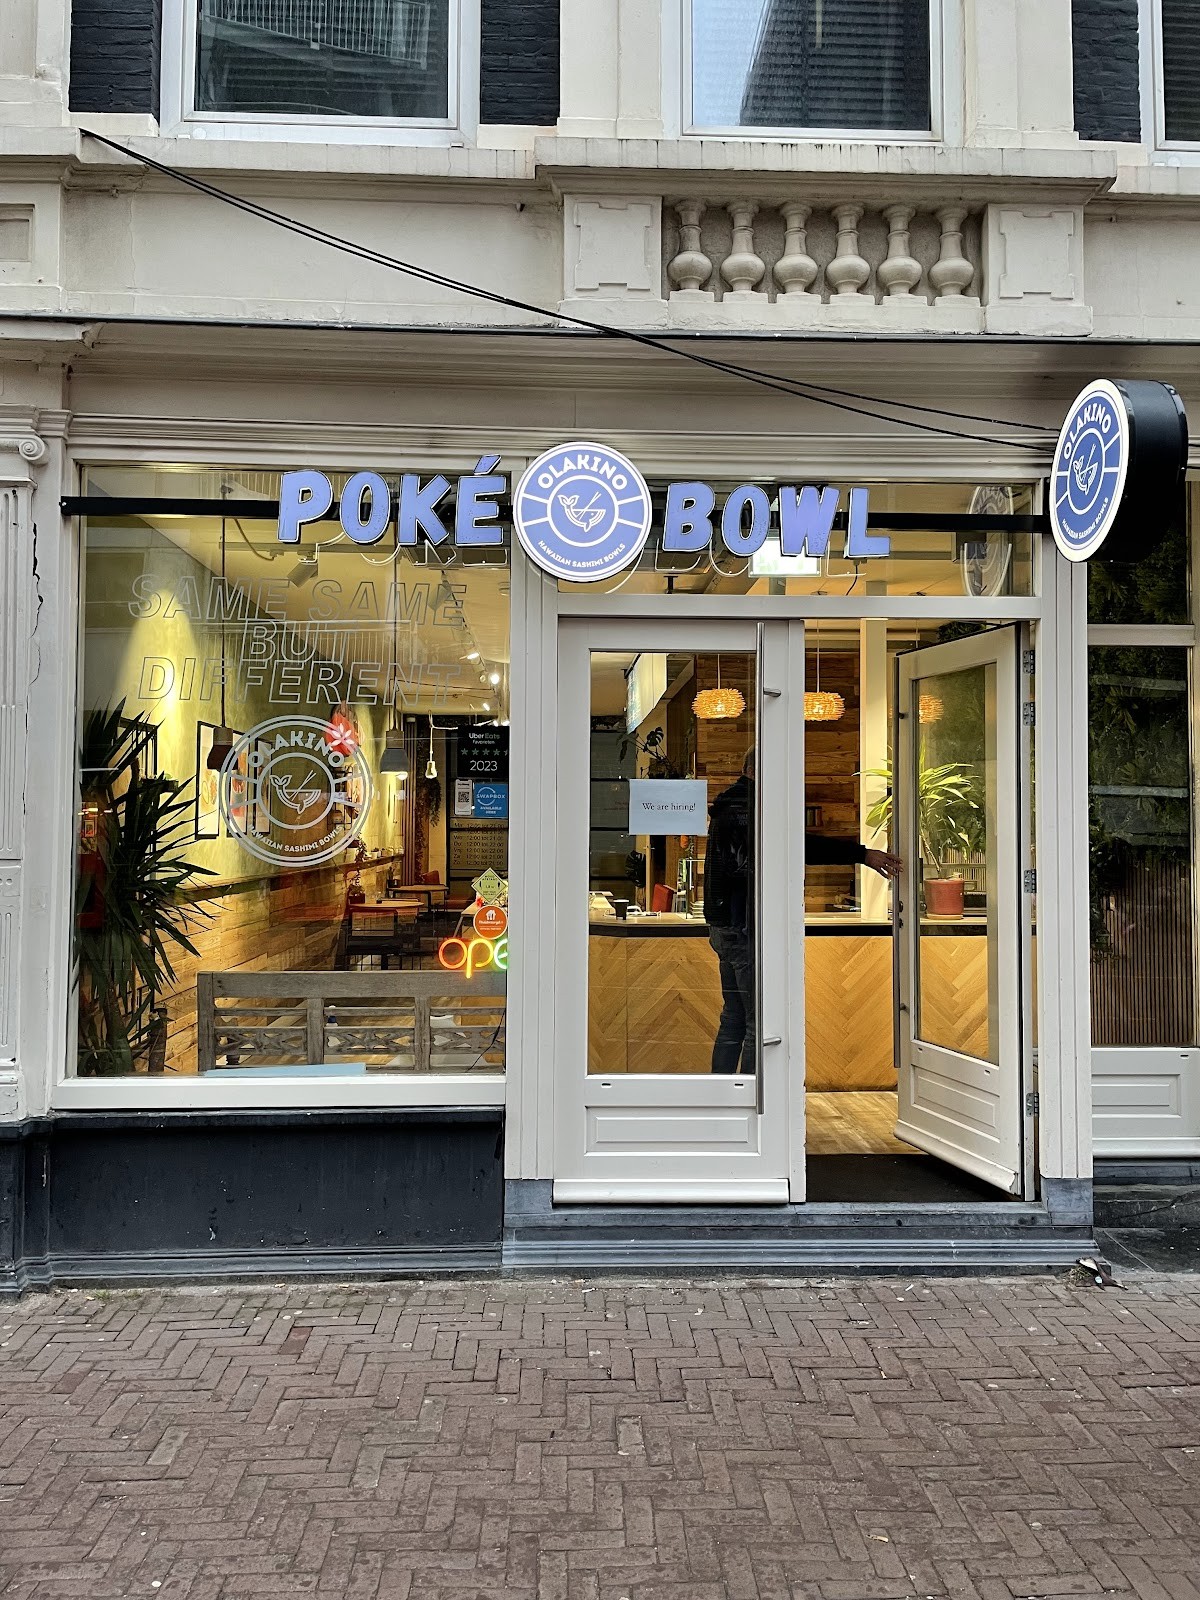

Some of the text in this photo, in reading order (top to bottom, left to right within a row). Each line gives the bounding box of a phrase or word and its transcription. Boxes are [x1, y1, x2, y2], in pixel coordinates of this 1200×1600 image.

[1063, 402, 1112, 460] OLAKINO
[537, 454, 628, 491] OLAKINO
[277, 454, 891, 559] POKÉ BOWL
[1095, 496, 1109, 525] BOWLS
[537, 540, 626, 568] HAWAIIAN SASHIMI BOWLS
[127, 573, 468, 627] SAME SAME
[240, 619, 360, 664] BUT
[137, 656, 462, 708] DIFFERENT
[248, 731, 345, 768] OLAKINO
[469, 759, 498, 772] 2023
[642, 802, 655, 811] We
[670, 802, 696, 812] hiring!
[284, 841, 319, 853] SASHIMI
[319, 824, 344, 847] BOWLS
